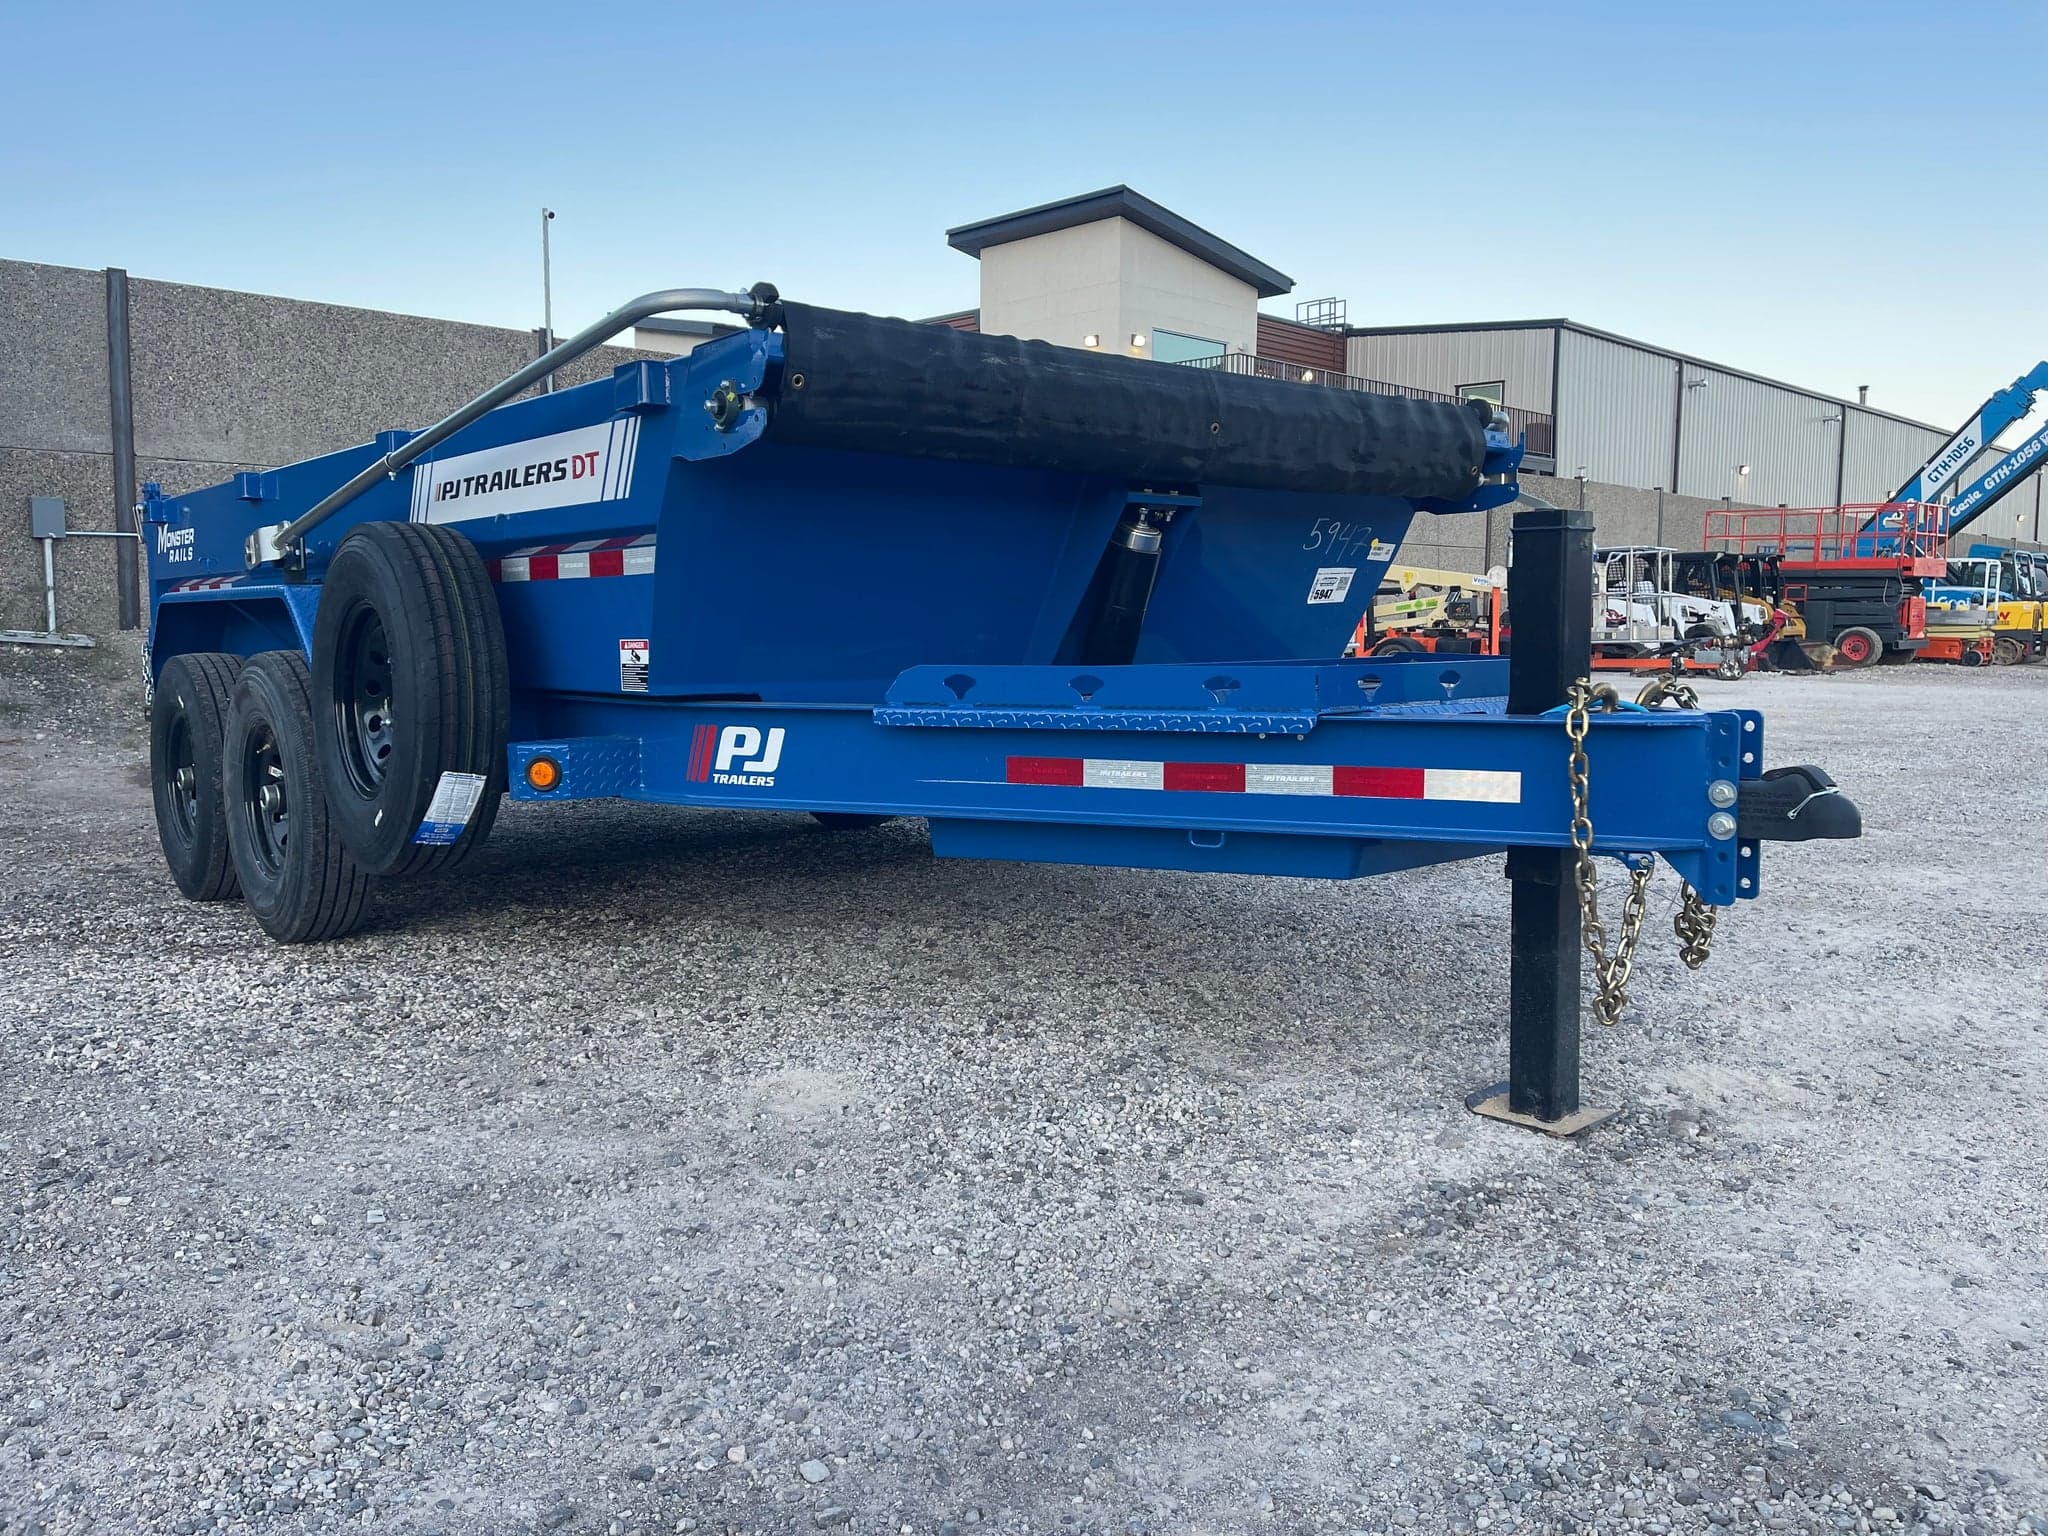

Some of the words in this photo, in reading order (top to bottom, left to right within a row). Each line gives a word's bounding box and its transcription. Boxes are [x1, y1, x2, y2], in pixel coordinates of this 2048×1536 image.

[1927, 436, 1976, 483] GTH-1056
[1949, 489, 1983, 517] Genie
[1983, 439, 2041, 490] GTH-1056
[169, 546, 194, 563] RAILS
[1302, 517, 1372, 563] 5947
[1313, 589, 1333, 600] 5947
[714, 725, 786, 773] PJ
[712, 773, 775, 787] TRAILERS
